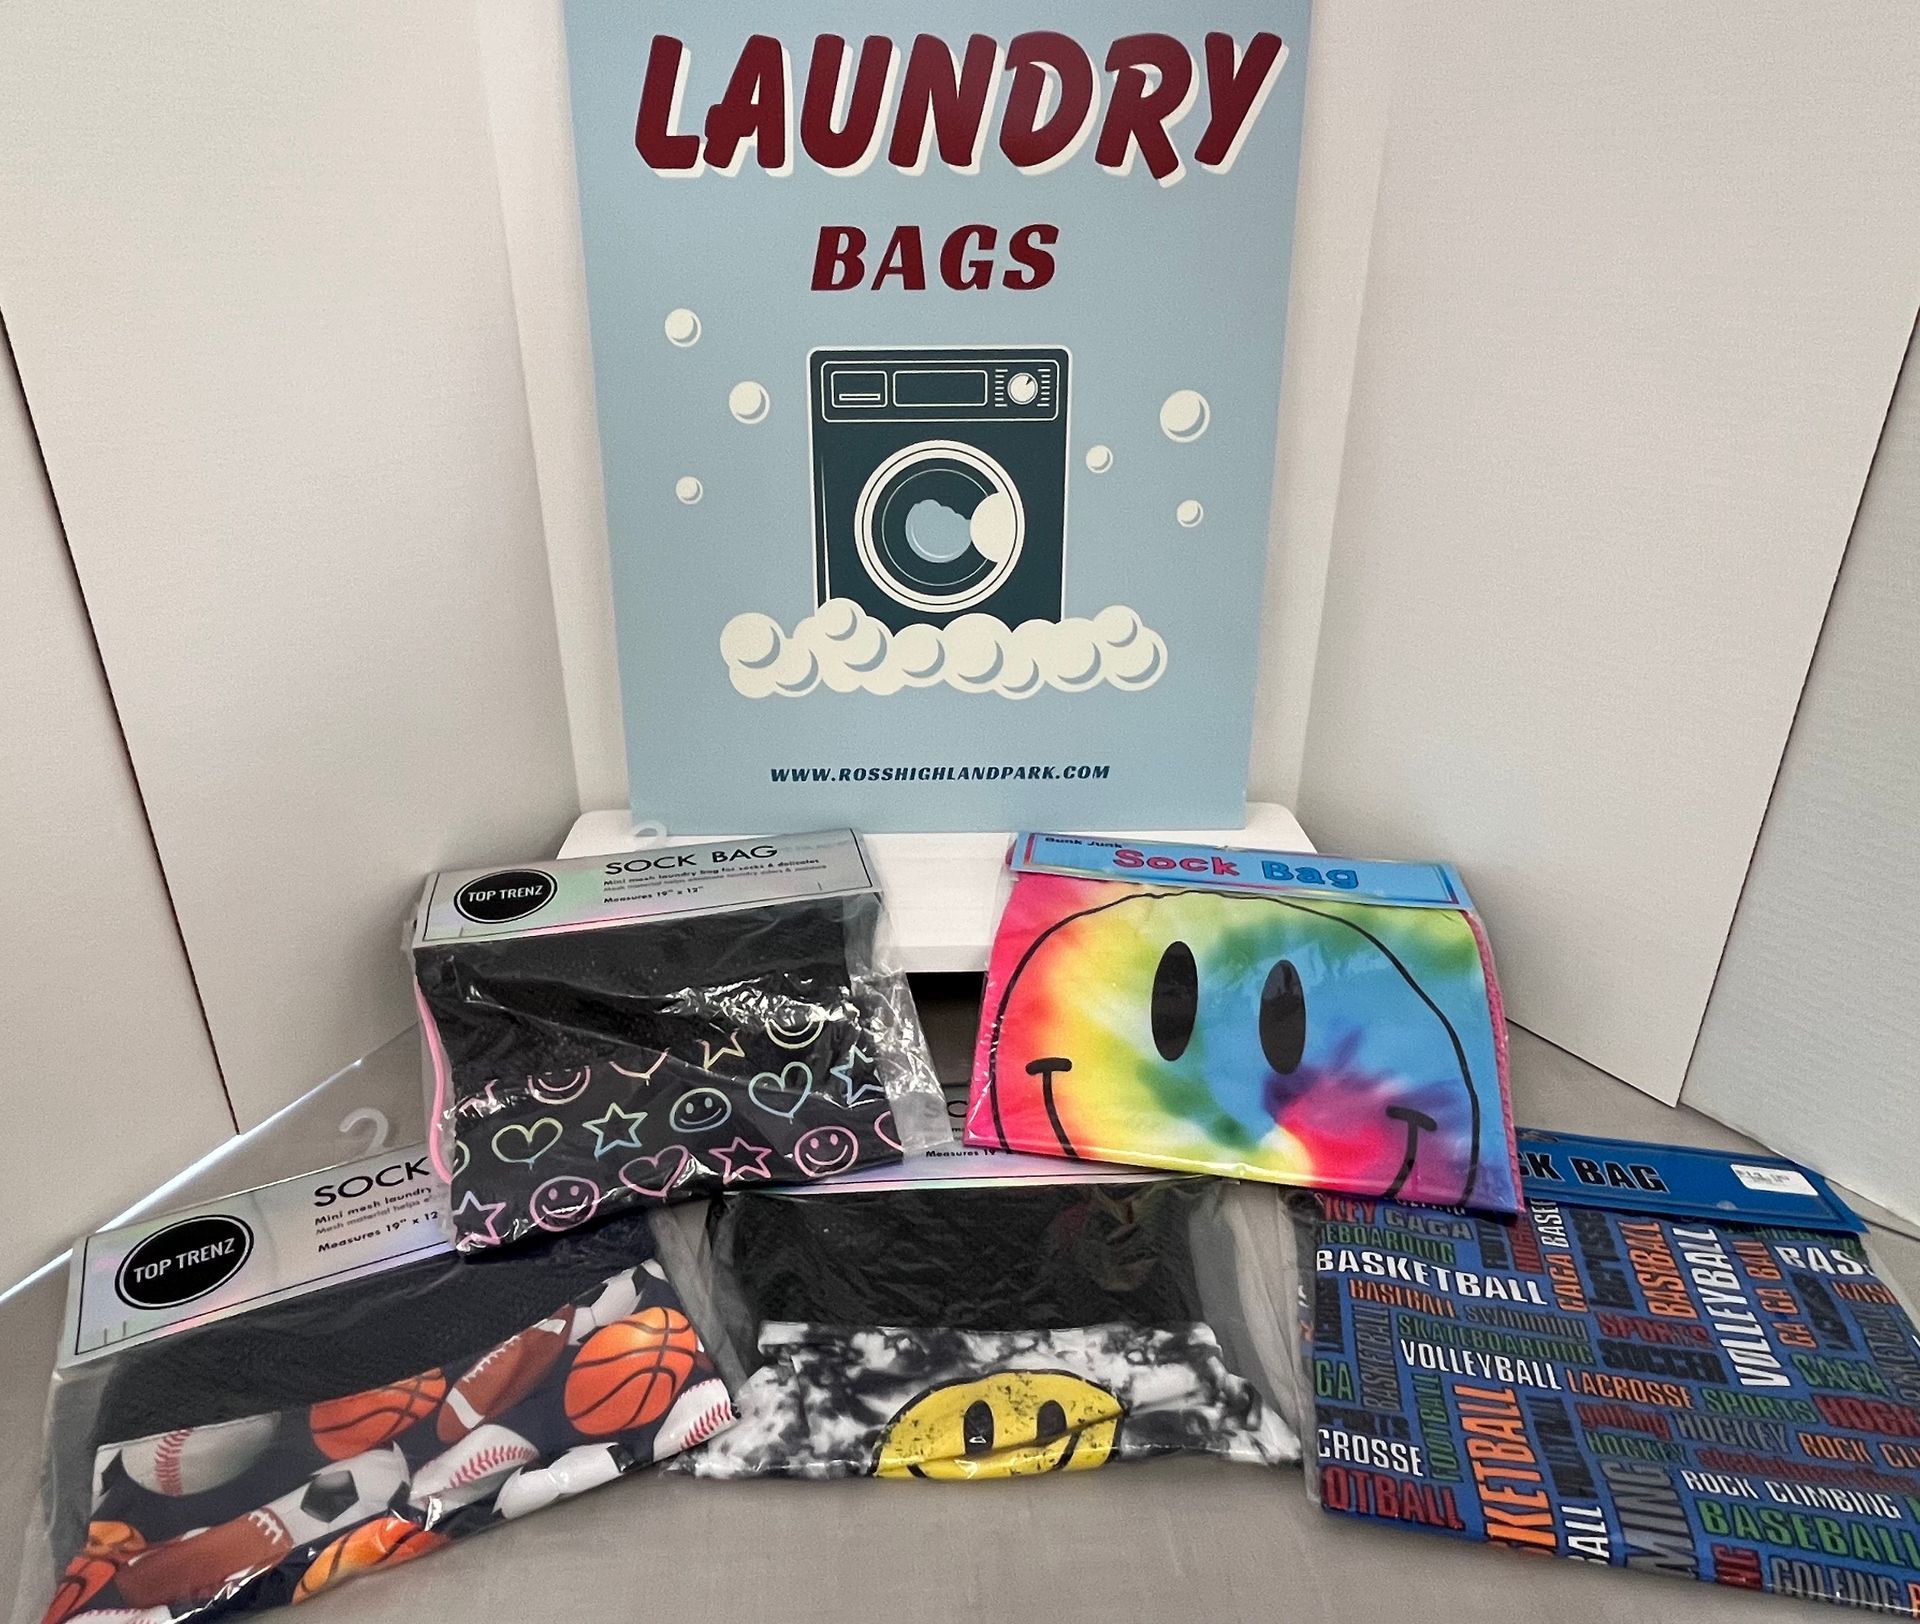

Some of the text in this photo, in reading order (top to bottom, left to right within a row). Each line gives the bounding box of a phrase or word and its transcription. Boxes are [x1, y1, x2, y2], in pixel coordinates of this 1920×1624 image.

[634, 31, 1287, 186] LAUNDRY
[811, 224, 1060, 291] BAGS
[770, 765, 1110, 782] WWW.ROSSHIGHLANDPARK.COM
[605, 854, 697, 875] SOCK
[711, 845, 778, 863] BAG
[1113, 849, 1359, 890] Sock Bag
[468, 885, 544, 903] TOP TRENZ
[603, 893, 652, 903] Measures
[925, 1149, 979, 1157] Measures
[314, 1156, 430, 1207] SOCK
[1568, 1157, 1670, 1194] BAG
[315, 1211, 343, 1226] Mini
[347, 1201, 380, 1215] mesh
[385, 1186, 432, 1204] laundry
[133, 1238, 235, 1283] TOP TRENZ
[318, 1229, 381, 1252] Measures
[1773, 1246, 1875, 1276] BAS
[1316, 1250, 1547, 1305] BASKETBALL
[1673, 1227, 1791, 1386] VOLLEYBALL
[1315, 1359, 1354, 1400] GA
[1401, 1340, 1562, 1390] VOLLEYBALL
[1567, 1369, 1694, 1409] LACROSSE
[1318, 1428, 1423, 1477] CROSSE
[1585, 1430, 1687, 1465] HOCKEY
[1675, 1411, 1791, 1453] HOCKEY
[1797, 1431, 1873, 1463] ROCK
[1453, 1384, 1558, 1554] KETBALL
[1322, 1468, 1465, 1530] OTBALL
[1681, 1470, 1759, 1499] ROCK
[1764, 1480, 1902, 1519] CLIMBING
[1560, 1504, 1609, 1564] ALL
[1700, 1500, 1920, 1569] BASEBALL
